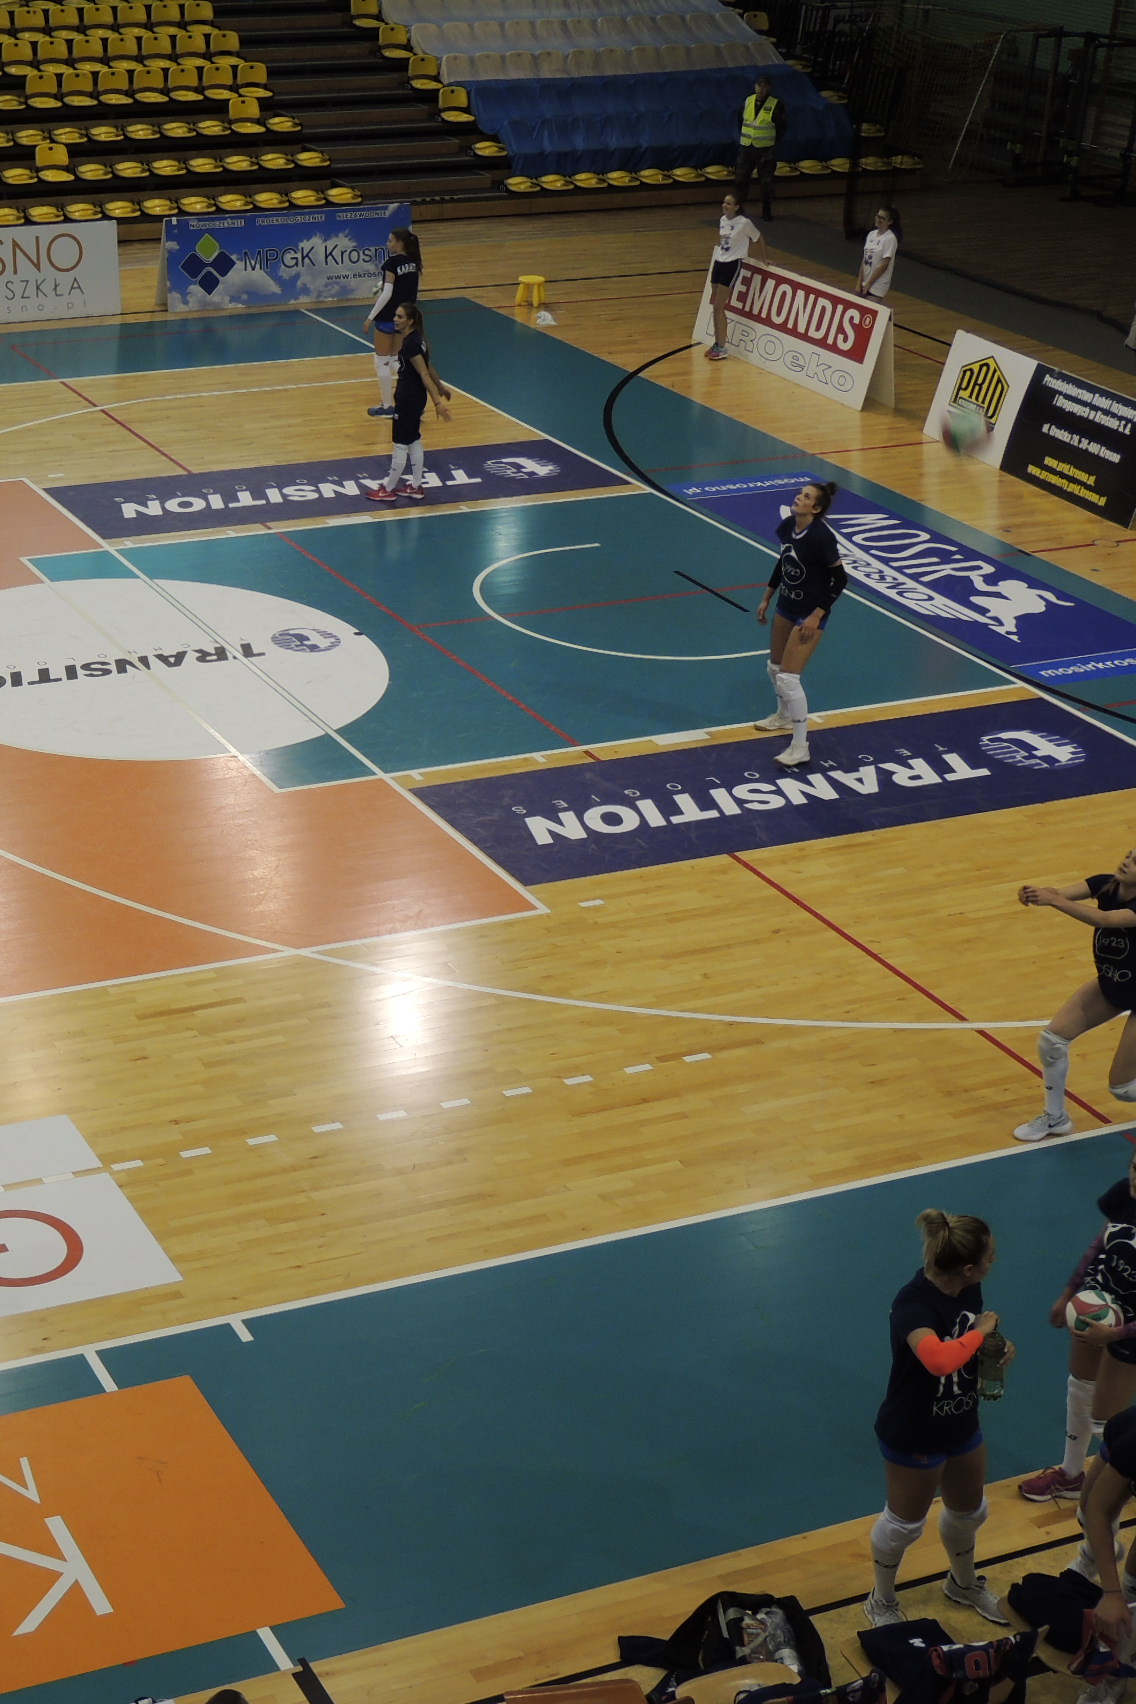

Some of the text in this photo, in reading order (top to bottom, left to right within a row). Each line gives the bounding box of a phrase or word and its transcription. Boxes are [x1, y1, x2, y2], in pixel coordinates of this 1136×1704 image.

[243, 244, 391, 272] MPGK Krosn
[327, 270, 383, 281] www.ekrosn
[4, 277, 85, 301] SZKŁA
[954, 361, 1005, 420] PRID
[1038, 655, 1136, 680] mosirkros
[524, 750, 992, 846] TRANSITION
